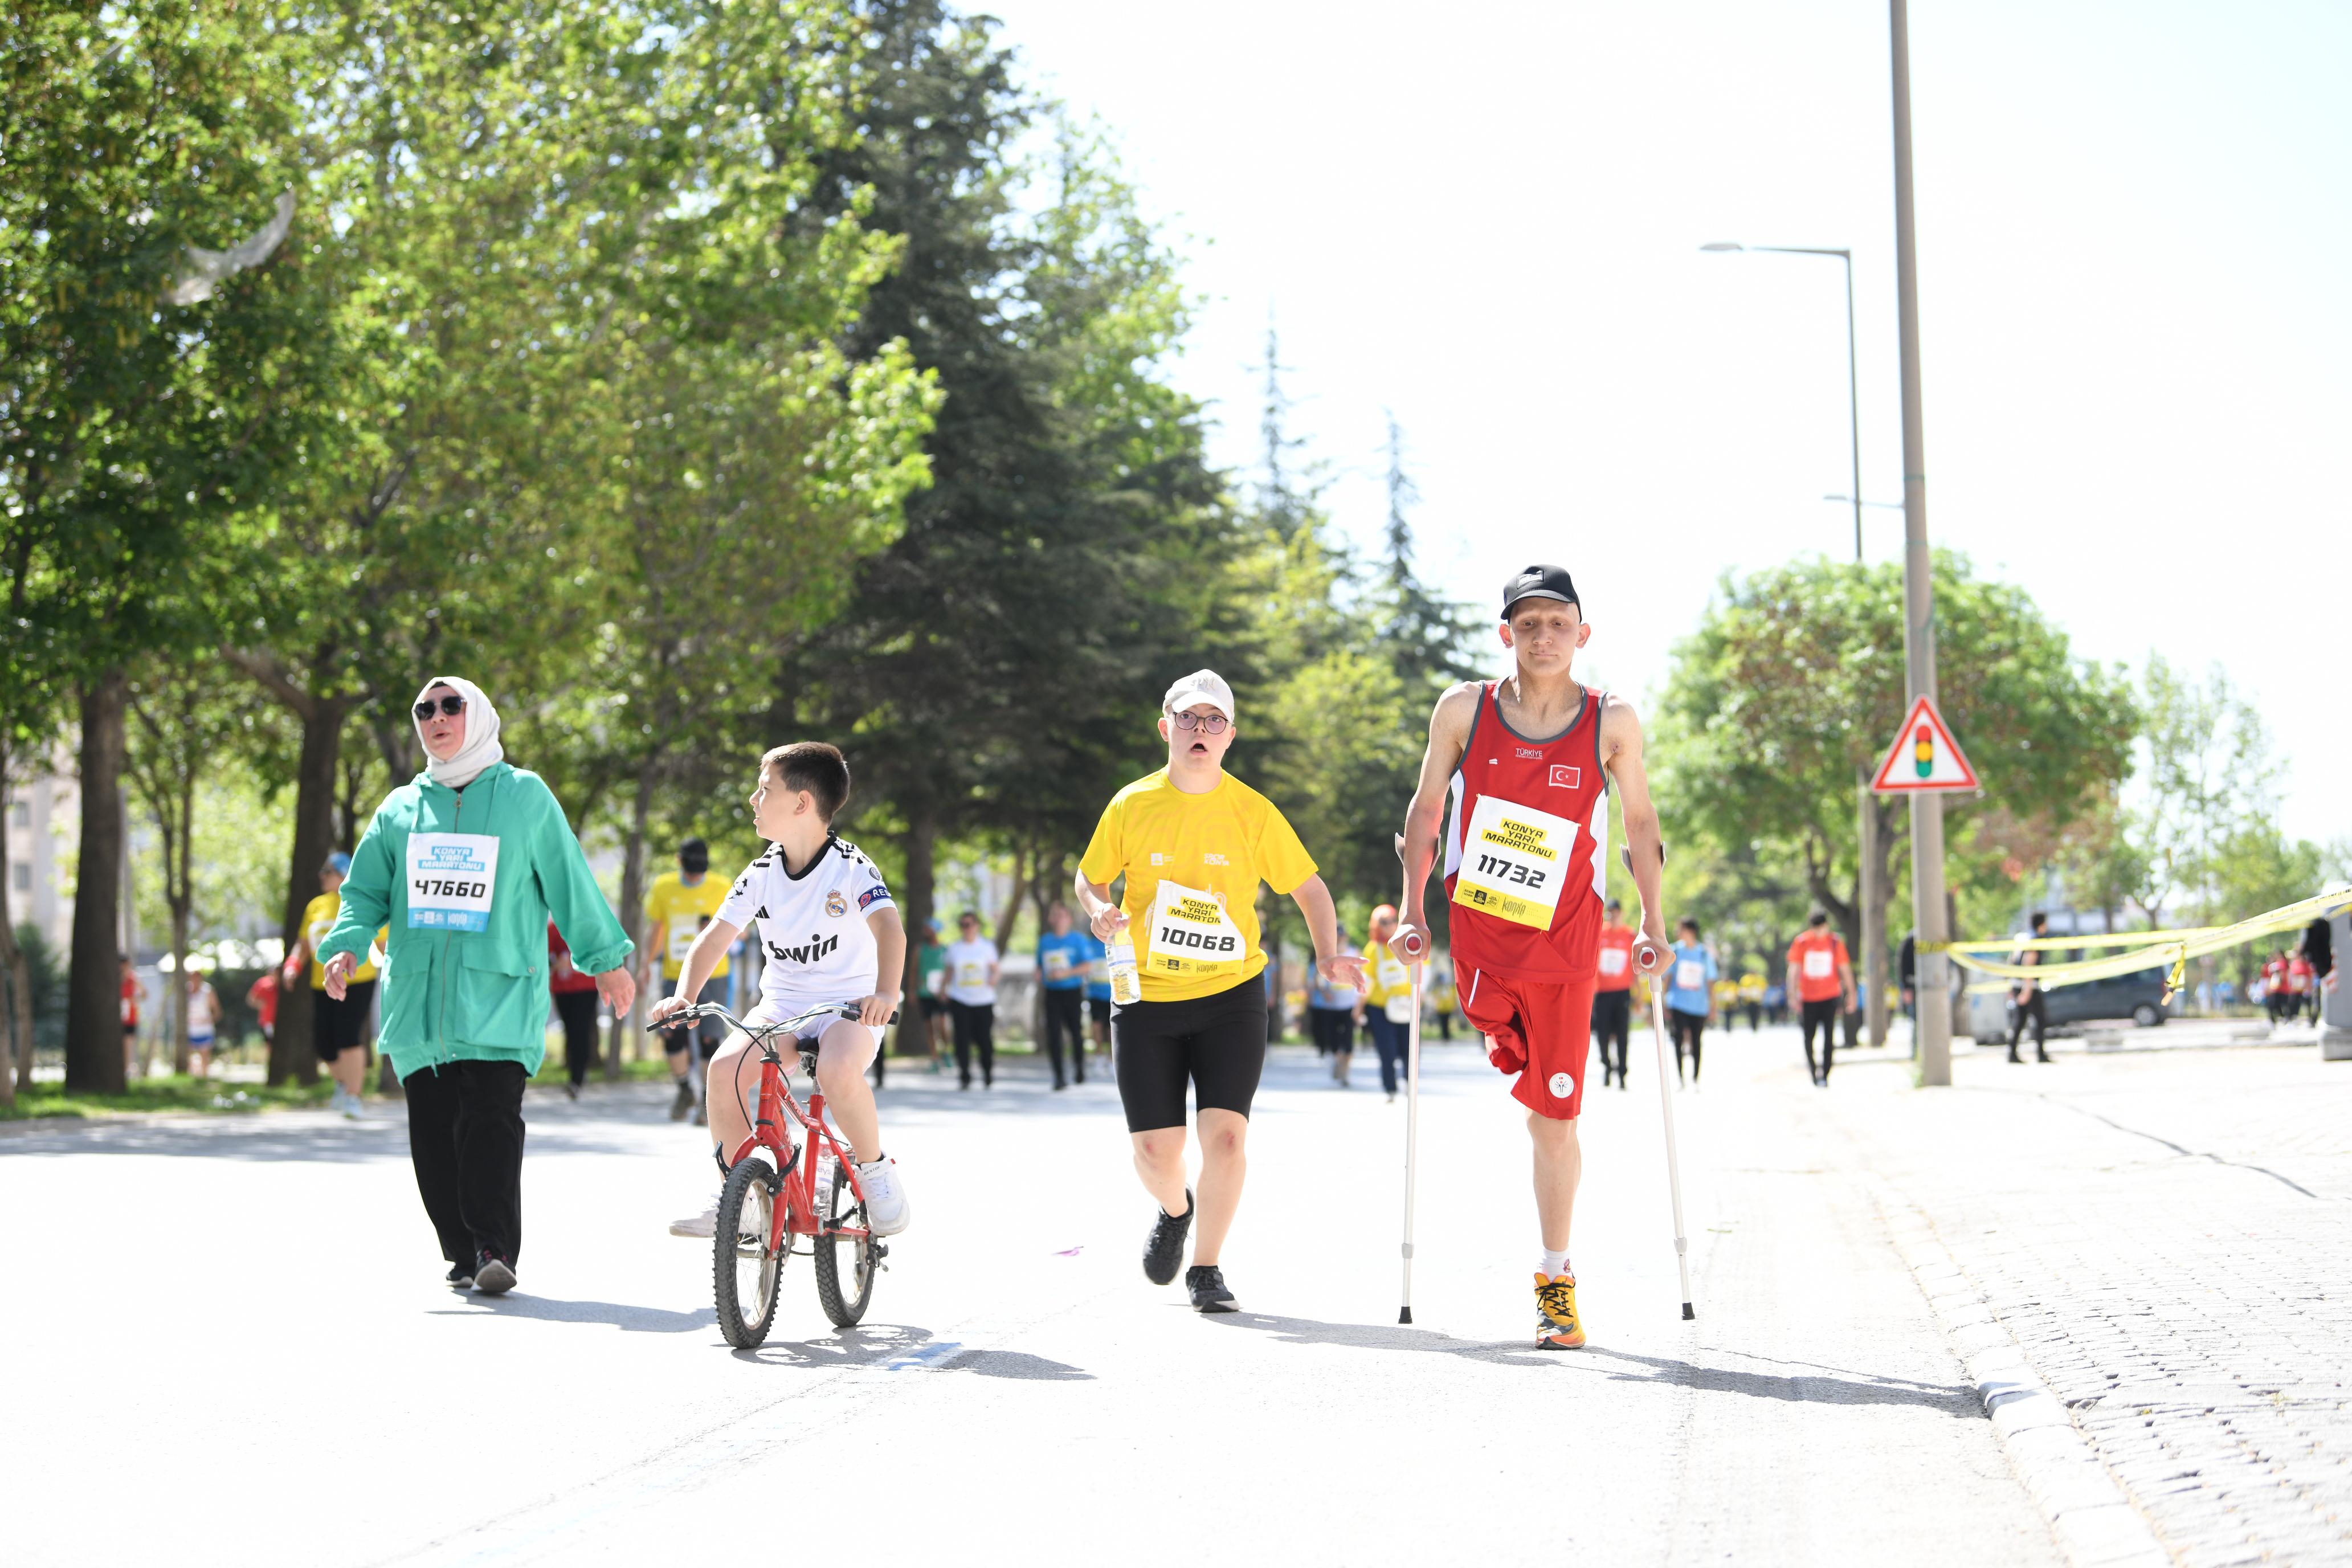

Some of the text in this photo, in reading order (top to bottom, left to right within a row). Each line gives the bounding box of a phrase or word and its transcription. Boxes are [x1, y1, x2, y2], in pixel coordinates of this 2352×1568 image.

[1516, 747, 1543, 757] TÜRKİYE
[1503, 821, 1544, 838] KONYA
[1508, 830, 1536, 844] YARI
[1485, 832, 1552, 858] MARATONU
[421, 861, 482, 870] MARATONU
[1477, 854, 1546, 889] 11732
[415, 880, 486, 898] 47660
[1183, 899, 1218, 910] KONYA
[1189, 906, 1211, 916] YARI
[1161, 926, 1235, 952] 10068
[767, 934, 838, 964] bwin
